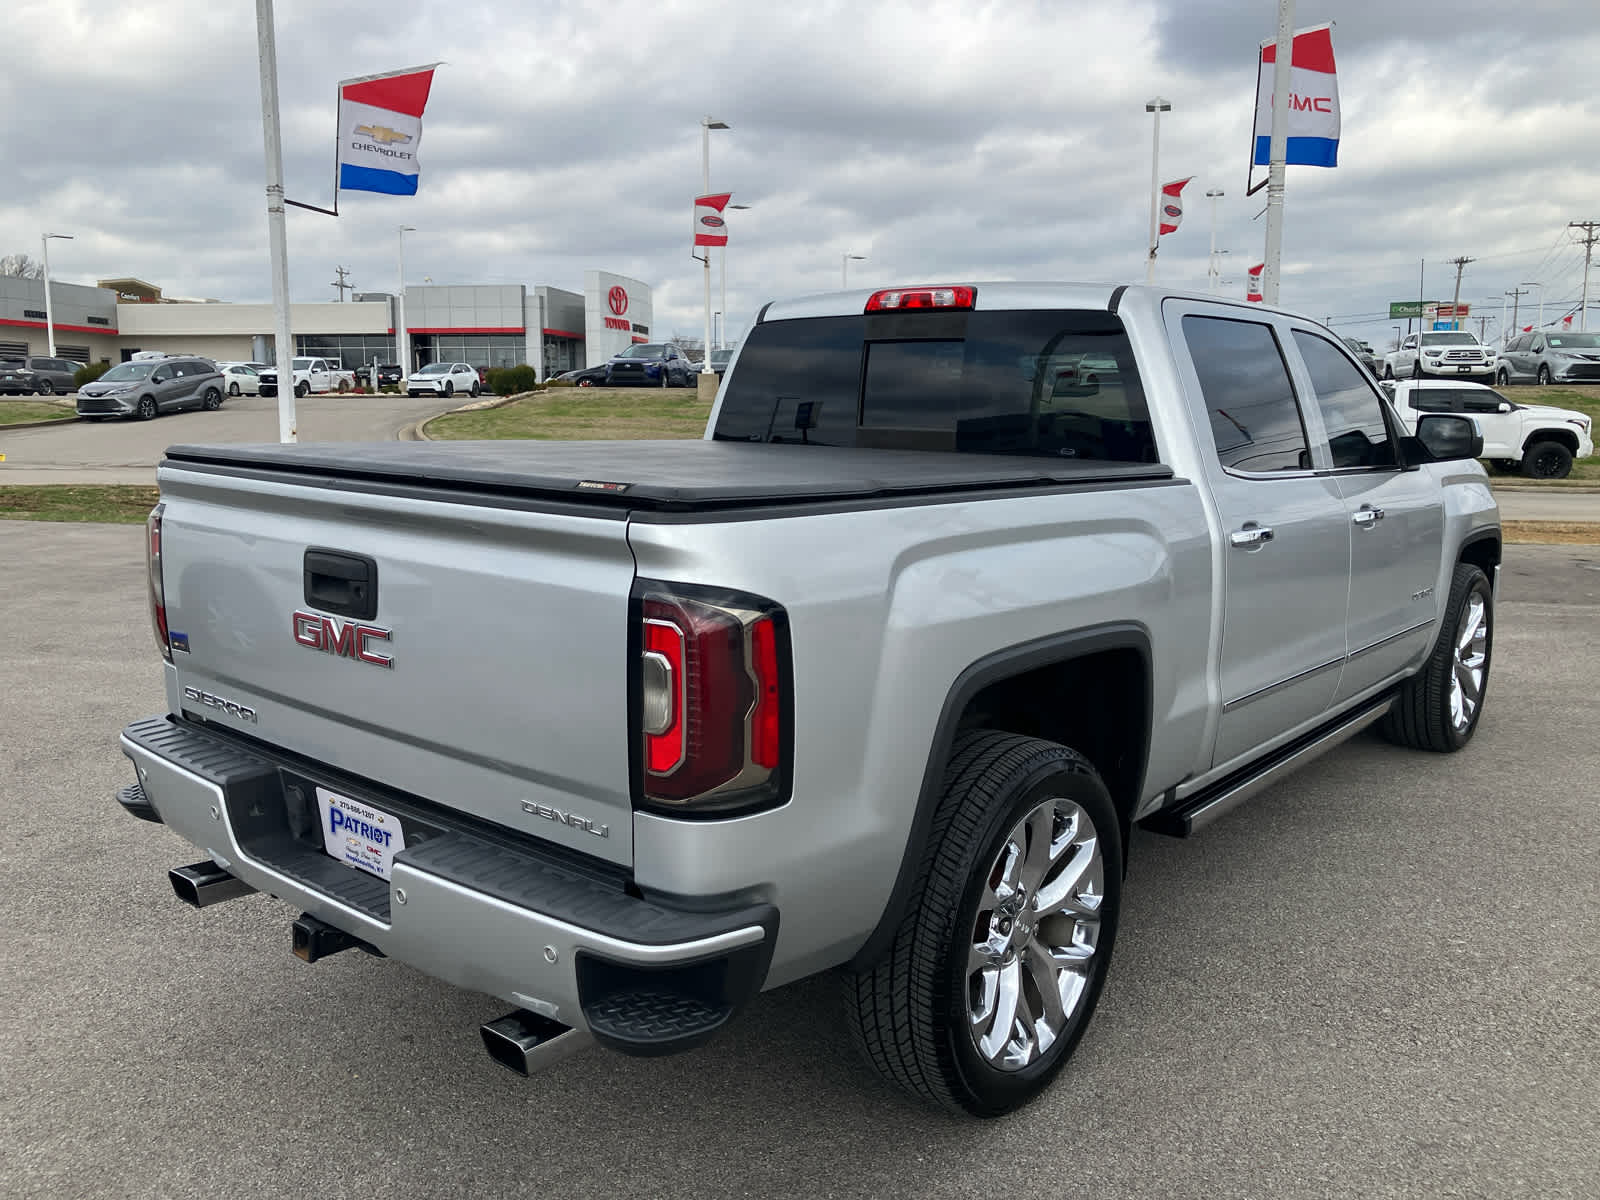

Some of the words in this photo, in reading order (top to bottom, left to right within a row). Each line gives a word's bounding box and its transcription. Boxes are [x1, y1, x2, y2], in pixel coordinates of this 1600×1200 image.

[352, 142, 413, 160] CHEVROLET
[604, 316, 630, 331] TOYOTA
[293, 610, 394, 670] GMC
[185, 685, 257, 724] SIERRA
[520, 799, 609, 838] DENALI
[366, 845, 382, 857] GMC
